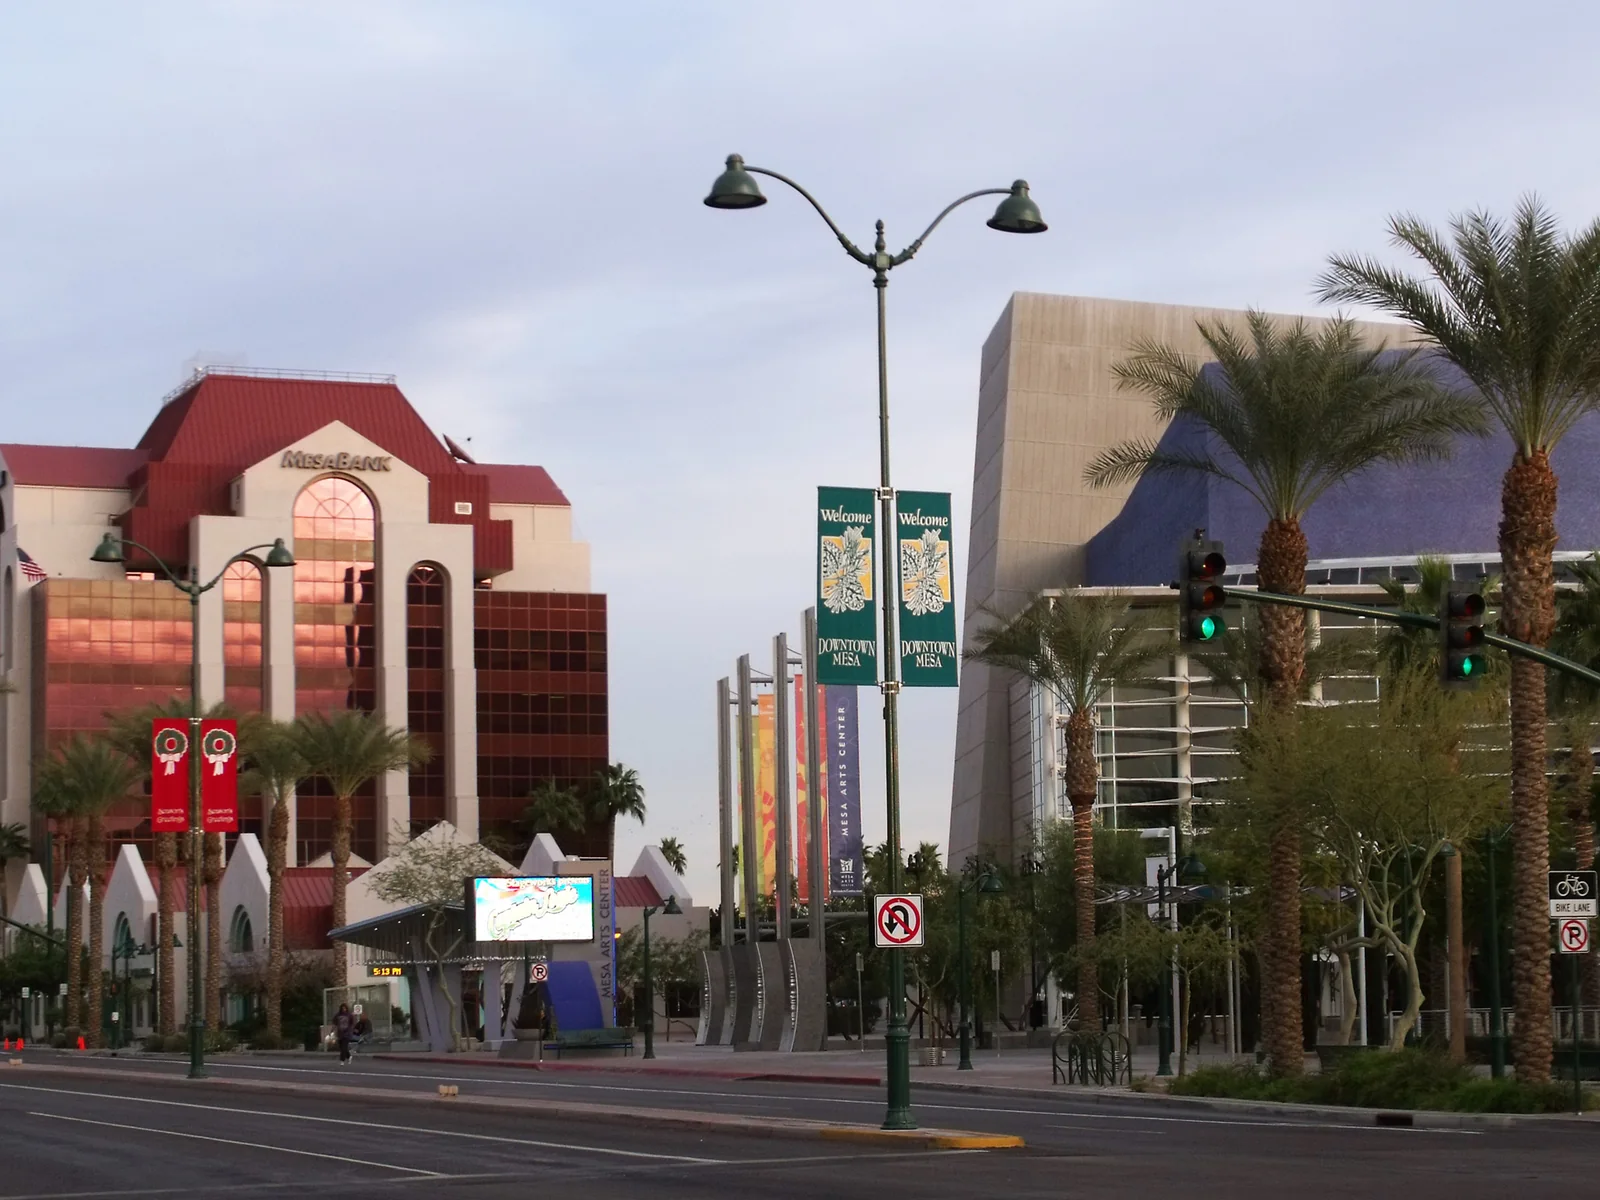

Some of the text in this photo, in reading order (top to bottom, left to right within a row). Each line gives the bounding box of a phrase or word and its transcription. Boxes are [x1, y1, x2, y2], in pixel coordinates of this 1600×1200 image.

[820, 505, 872, 524] Welcome
[899, 508, 949, 527] Welcome
[818, 637, 876, 658] DOWNTOWN
[901, 640, 956, 658] DOWNTOWN
[832, 651, 861, 667] MESA
[915, 653, 942, 668] MESA
[838, 707, 849, 837] MESA ARTS CENTER
[1556, 903, 1591, 912] BIKE LANE
[600, 869, 611, 998] MESA ARTS CENTER
[373, 967, 390, 976] 5:13
